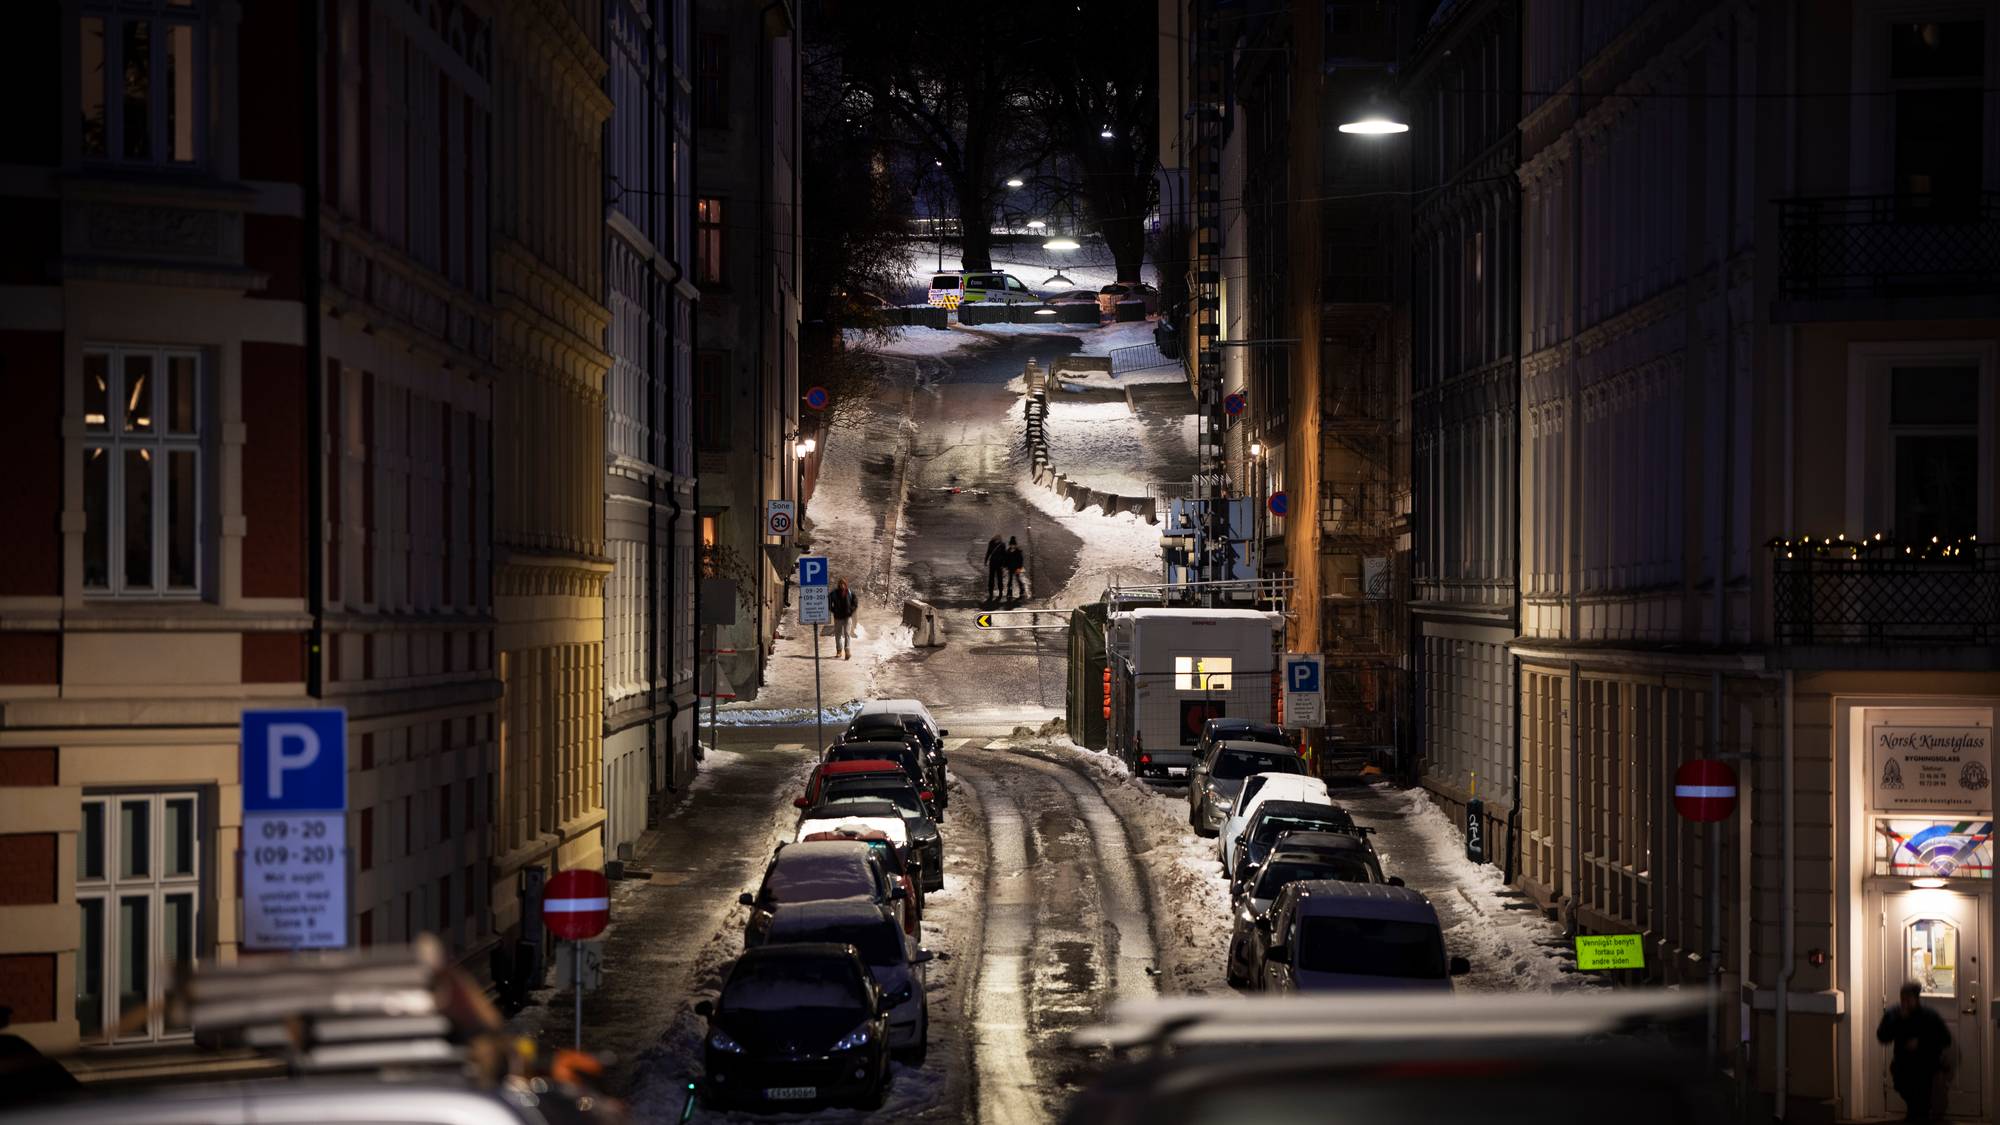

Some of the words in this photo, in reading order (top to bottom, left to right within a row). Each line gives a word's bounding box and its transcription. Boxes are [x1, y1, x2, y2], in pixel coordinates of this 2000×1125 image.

[774, 517, 787, 528] 30
[806, 561, 821, 583] P
[1294, 665, 1311, 689] P
[1880, 733, 1918, 750] Norsk
[1919, 733, 1984, 753] Kunstglass
[267, 722, 321, 800] P
